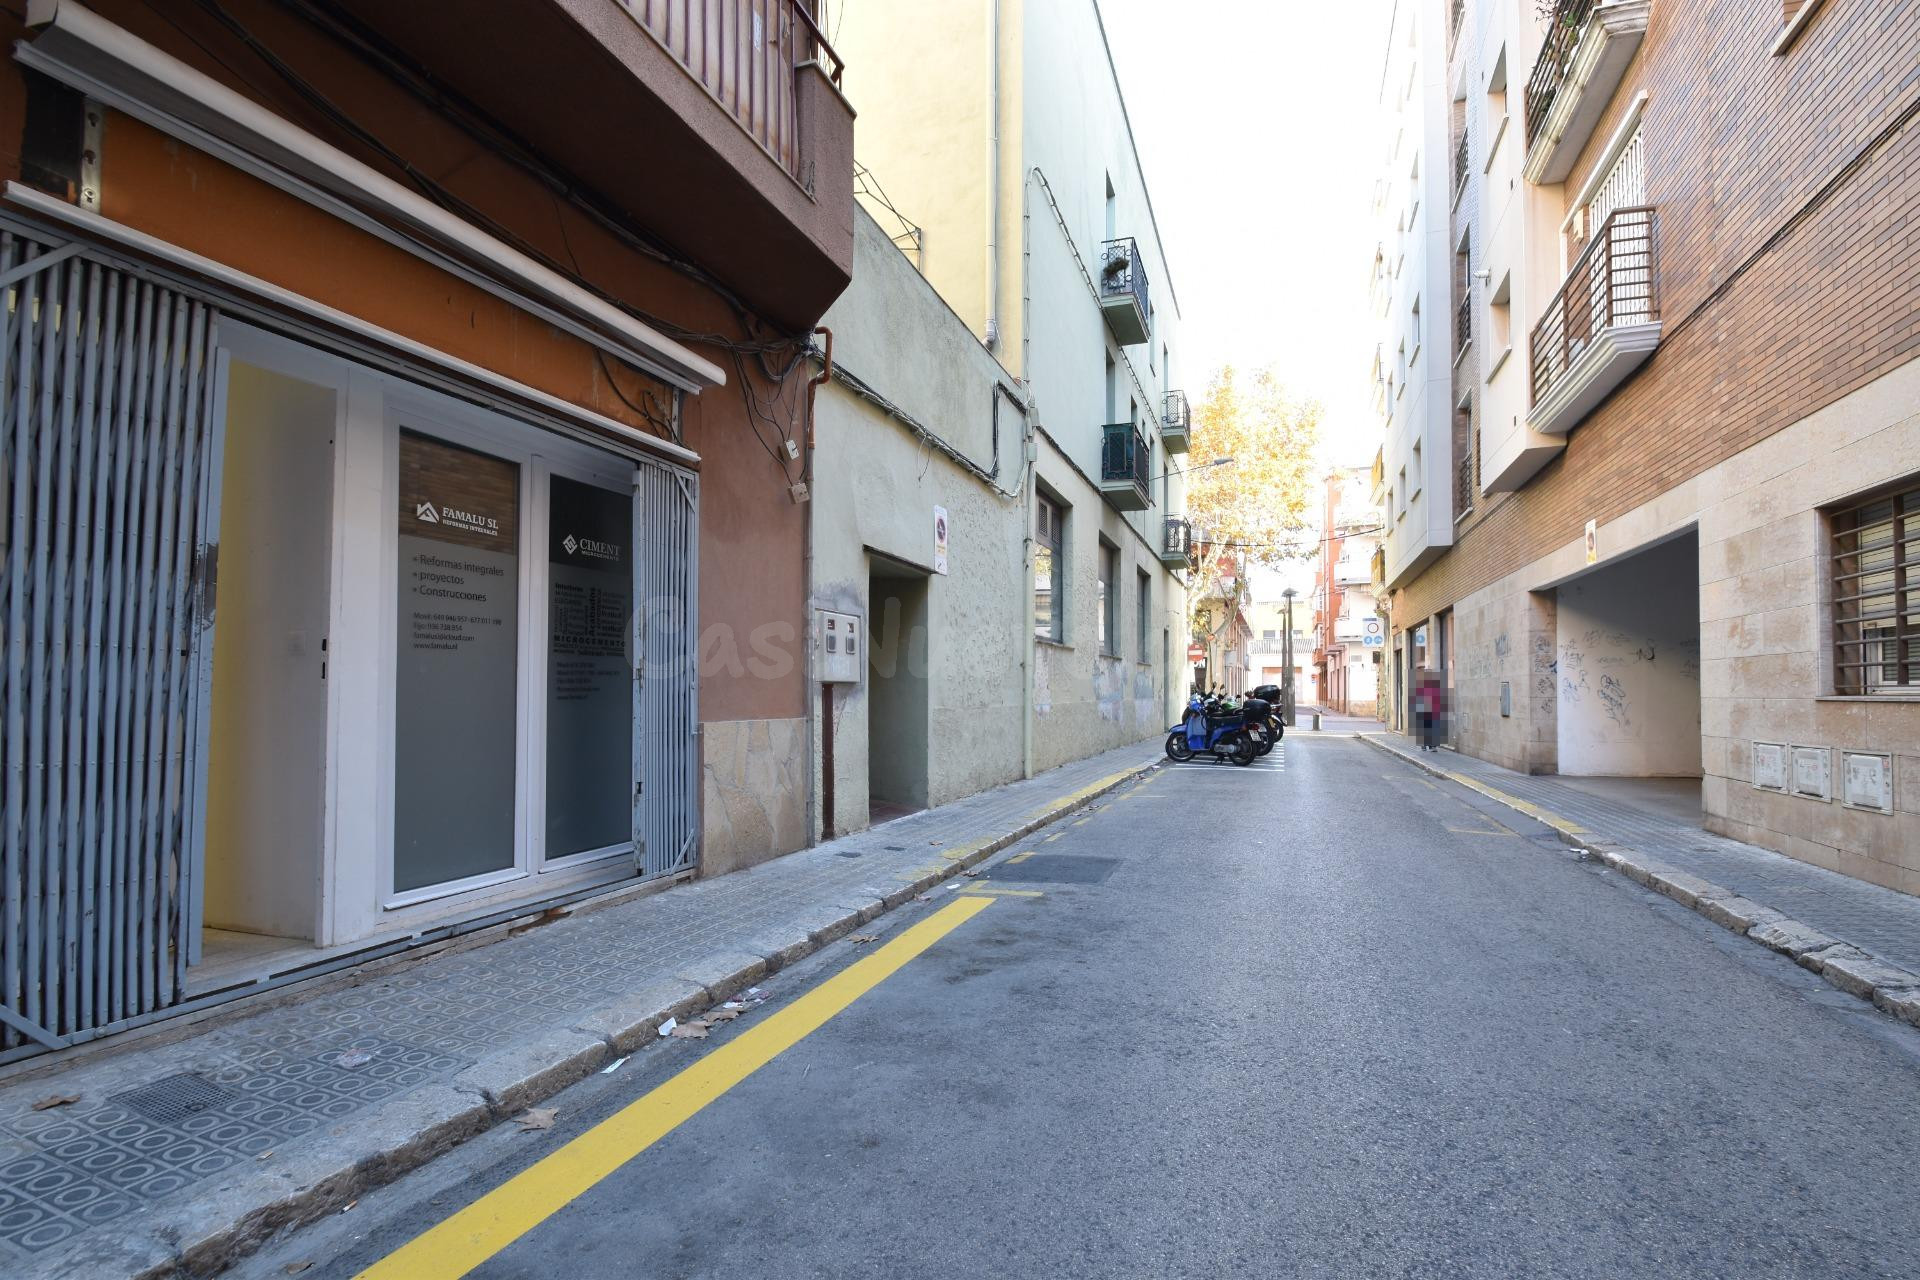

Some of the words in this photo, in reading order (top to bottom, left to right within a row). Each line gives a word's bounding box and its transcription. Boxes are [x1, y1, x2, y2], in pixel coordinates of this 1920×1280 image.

[442, 507, 485, 526] FAMALU
[487, 518, 499, 530] SL
[442, 519, 469, 530] REFORMAS
[469, 524, 498, 537] INTEGRALES
[580, 538, 622, 556] CIMENT
[420, 554, 462, 570] Reformas
[464, 561, 504, 577] integrales
[420, 571, 465, 585] proyectos
[420, 584, 487, 602] Construcciones
